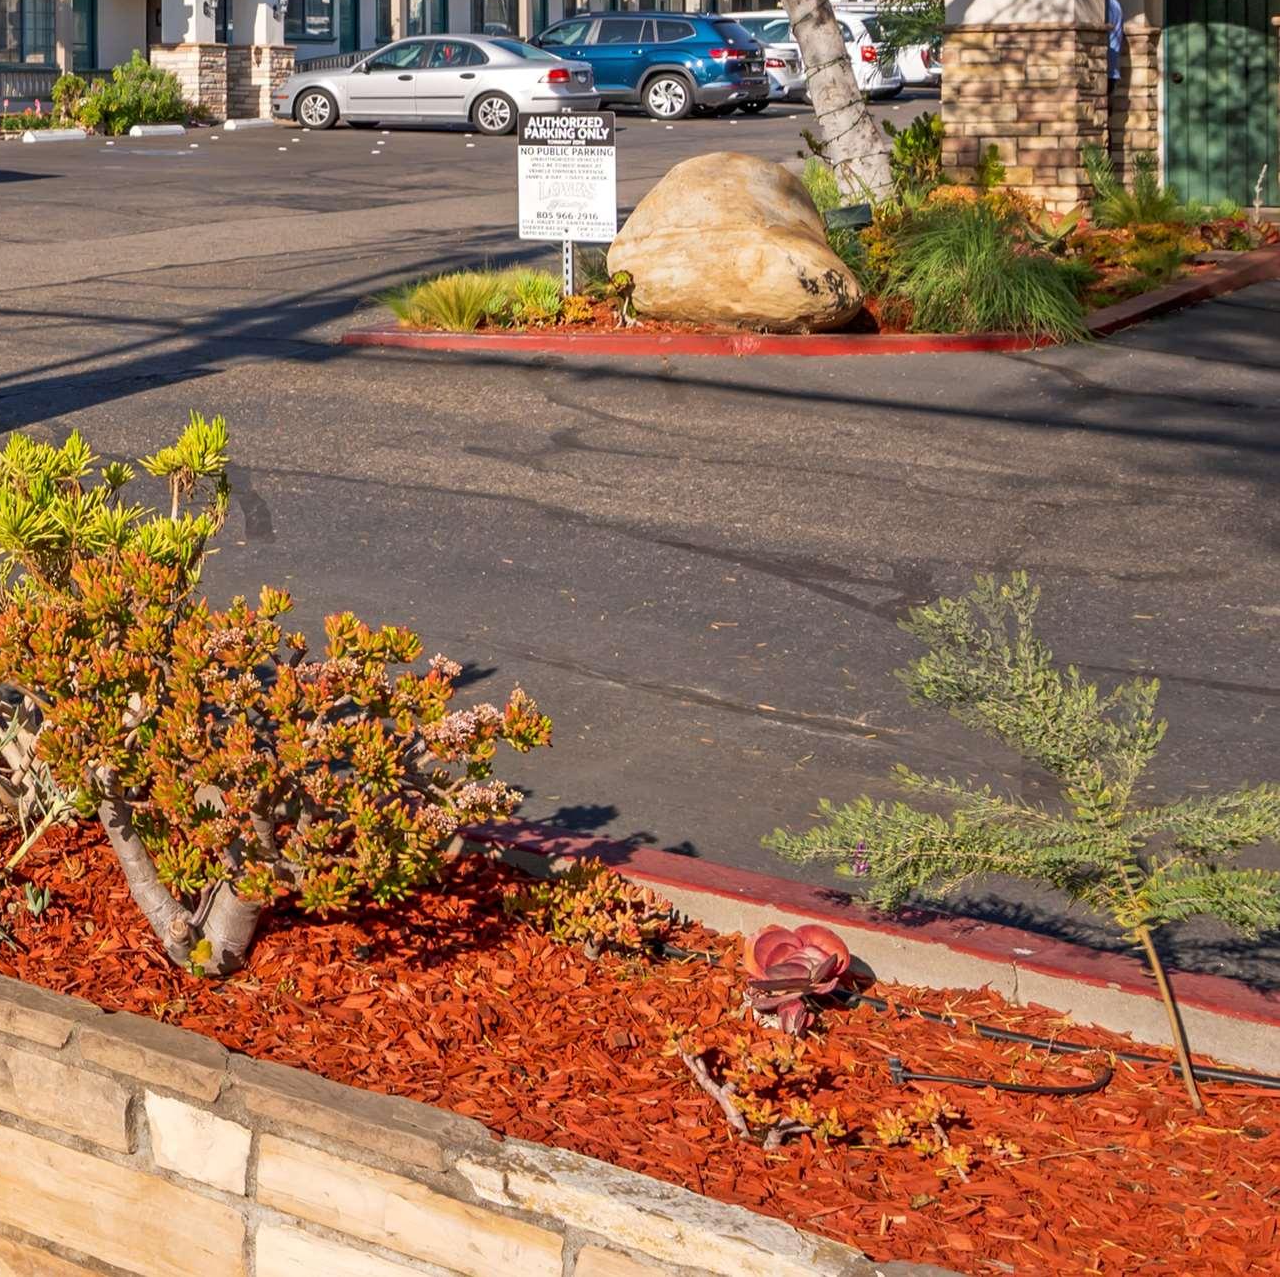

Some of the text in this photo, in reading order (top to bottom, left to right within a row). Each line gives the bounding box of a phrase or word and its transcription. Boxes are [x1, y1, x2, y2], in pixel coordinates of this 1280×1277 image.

[528, 116, 603, 128] AUTHORIZED
[524, 127, 610, 140] PARKING ONLY
[521, 147, 614, 156] NO PUBLIC PARKING
[537, 211, 553, 219] 805
